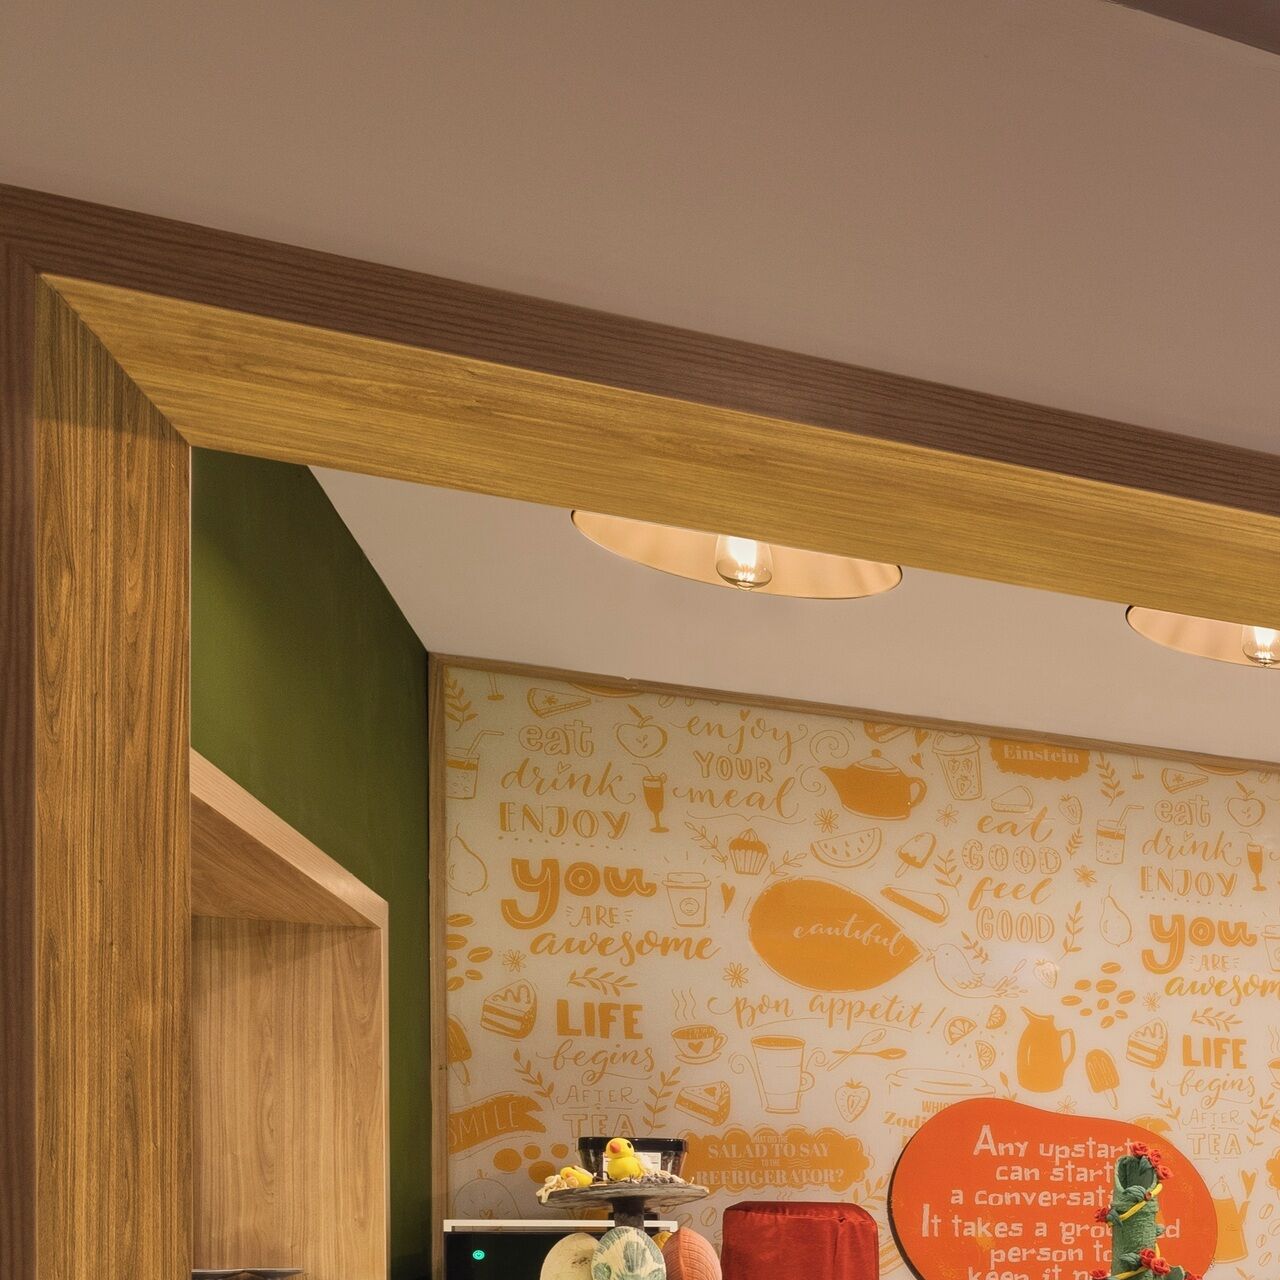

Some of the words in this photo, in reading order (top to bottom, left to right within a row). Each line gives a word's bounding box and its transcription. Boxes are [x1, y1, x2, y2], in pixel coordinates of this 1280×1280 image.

[518, 718, 594, 757] eat
[680, 708, 800, 765] enjoy
[1003, 743, 1080, 765] Einstein
[500, 756, 636, 805] drink
[692, 750, 774, 784] YOUR
[677, 776, 800, 820] meal
[1153, 795, 1211, 828] eat
[498, 800, 631, 840] ENJOY
[977, 806, 1053, 842] eat
[962, 839, 1062, 875] GOOD
[1141, 828, 1241, 868] drink
[501, 857, 658, 930] you
[968, 875, 1053, 911] feel
[1140, 866, 1238, 897] ENJOY
[566, 904, 622, 929] ARE
[975, 906, 1055, 944] GOOD
[529, 930, 724, 967] awesome
[1142, 914, 1258, 975] you
[1195, 954, 1229, 973] ARE
[556, 999, 644, 1039] LIFE
[722, 993, 794, 1030] Bon
[547, 1040, 656, 1086] begins
[1182, 1033, 1248, 1070] LIFE
[1176, 1069, 1256, 1109] begins
[562, 1114, 638, 1138] TEA
[1186, 1133, 1242, 1156] TEA
[973, 1124, 1029, 1158] Any
[1038, 1136, 1135, 1166] upstart
[995, 1165, 1040, 1182] can
[1049, 1160, 1114, 1183] start
[950, 1188, 964, 1206] a
[921, 1203, 942, 1238] It
[951, 1216, 1023, 1238] takes
[1034, 1220, 1048, 1238] a
[990, 1244, 1083, 1270] person
